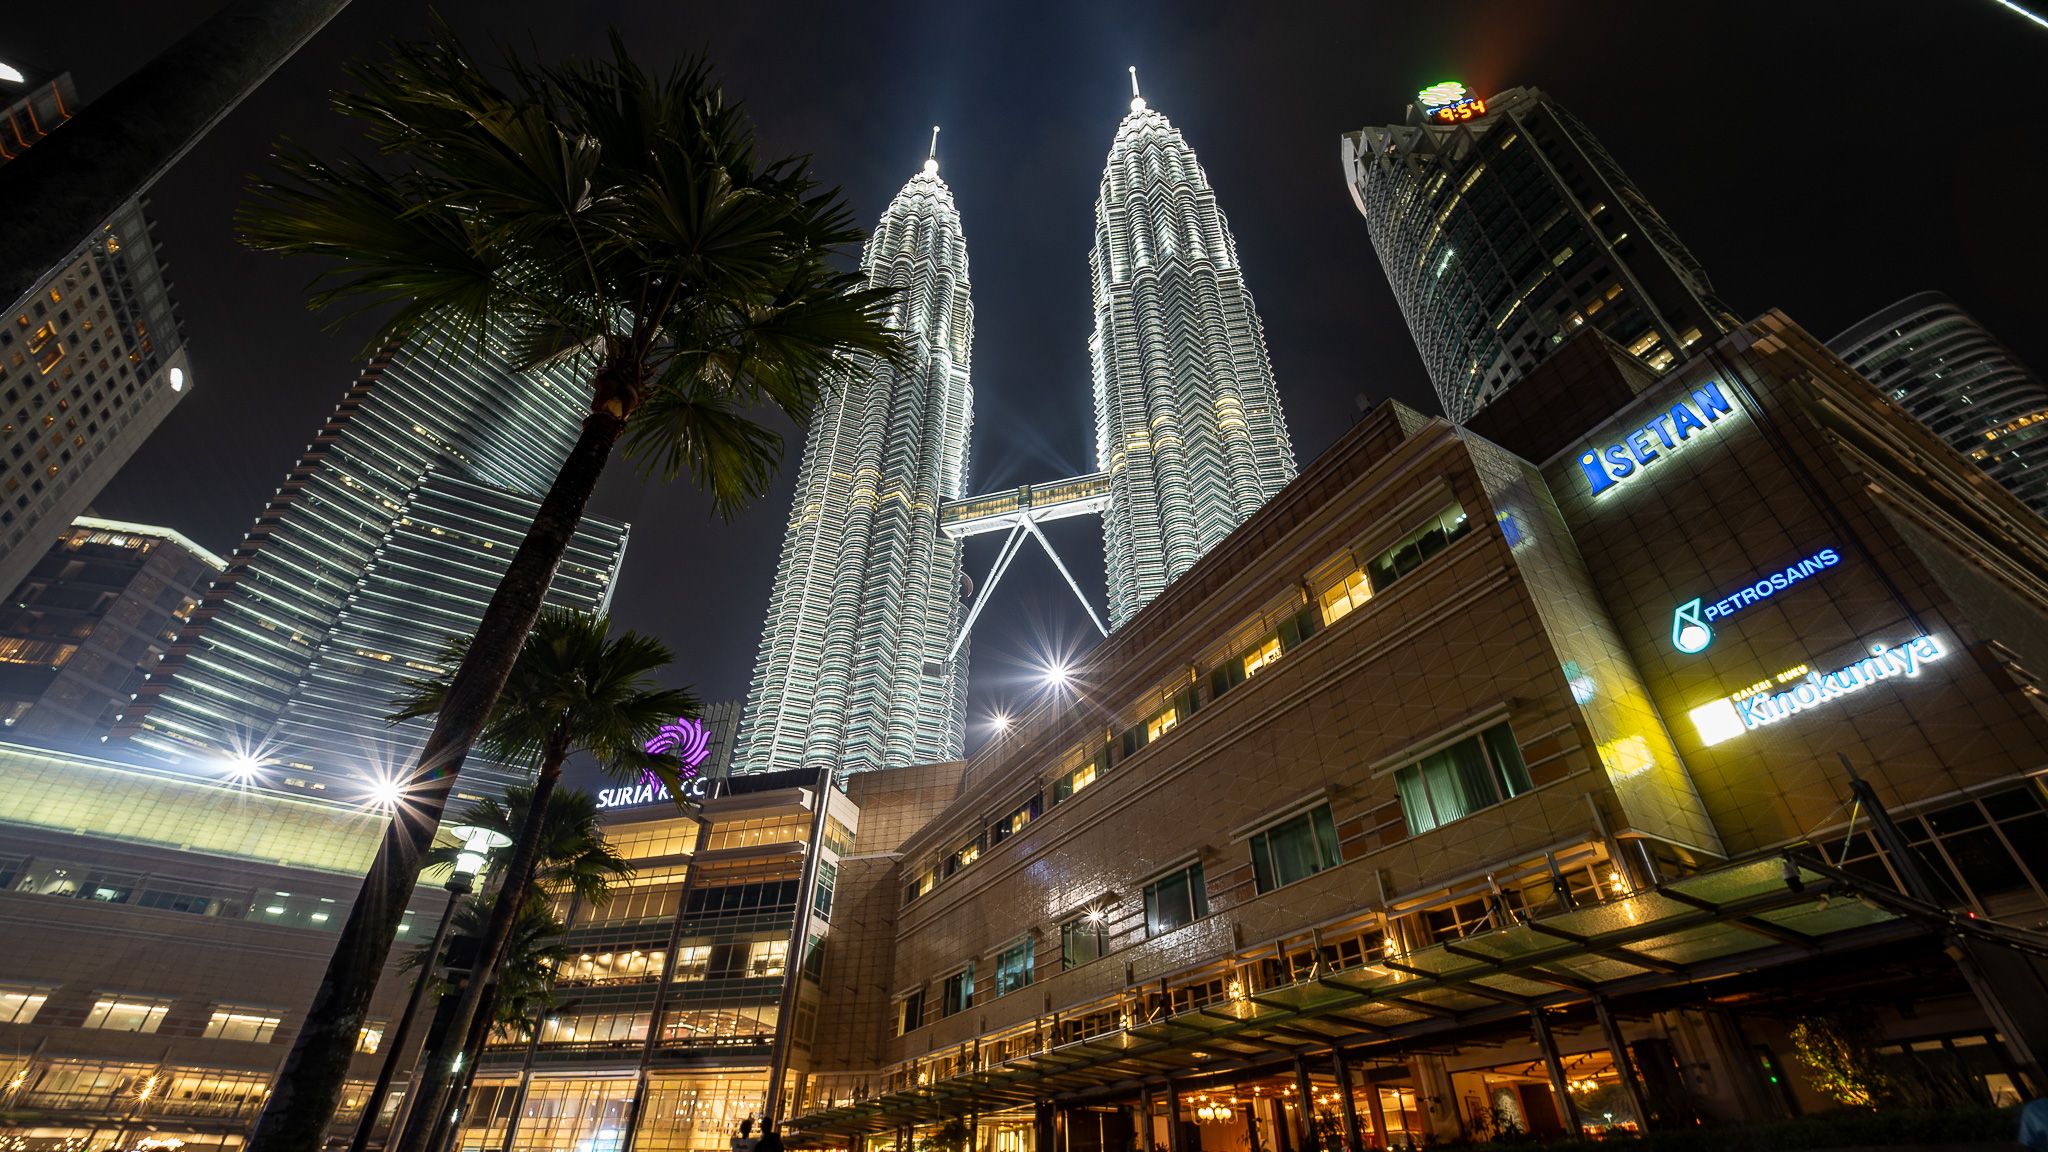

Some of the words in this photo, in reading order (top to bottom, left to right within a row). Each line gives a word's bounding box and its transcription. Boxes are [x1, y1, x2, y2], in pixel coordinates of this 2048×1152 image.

[1440, 100, 1486, 120] 9:54
[1704, 549, 1840, 621] PETROSAINS
[1735, 635, 1942, 728] Kinokuniya
[596, 783, 653, 808] SURIA
[658, 777, 708, 800] KCC
